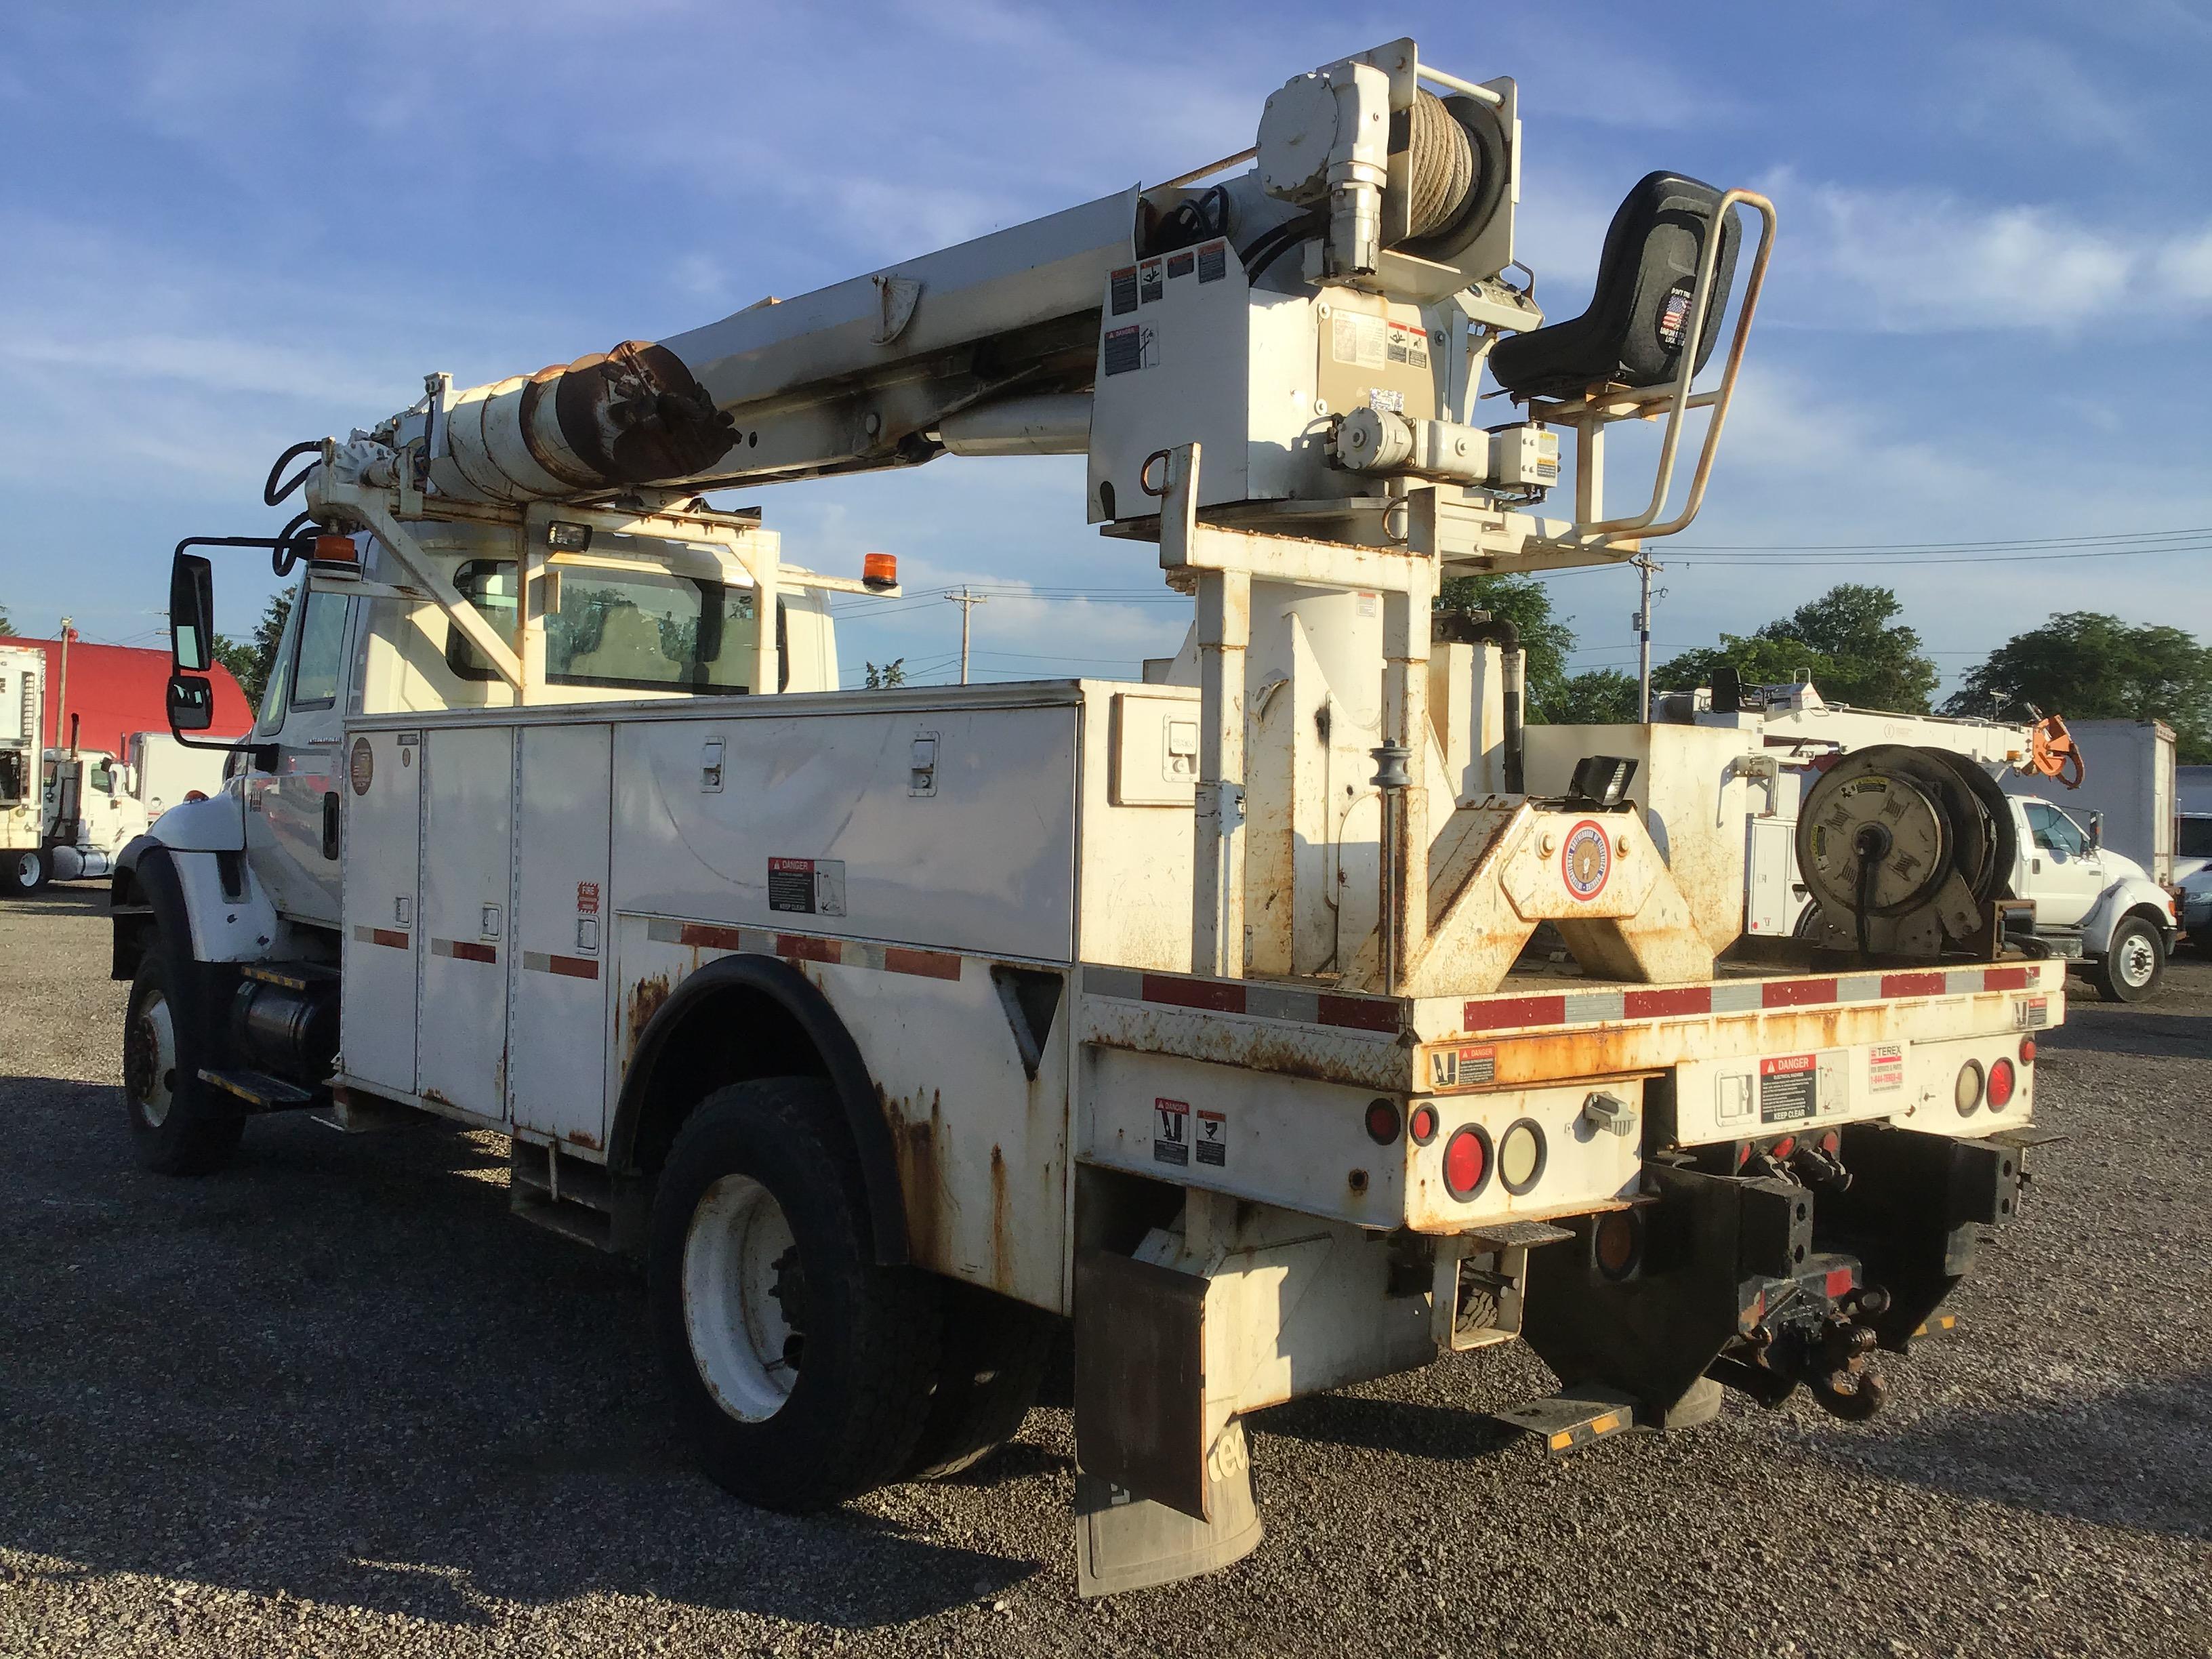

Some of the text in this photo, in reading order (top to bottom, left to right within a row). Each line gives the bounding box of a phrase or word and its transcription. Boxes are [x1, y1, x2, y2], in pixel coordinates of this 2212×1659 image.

[781, 860, 808, 870] DANGER
[1471, 1048, 1493, 1057] DANGER
[1877, 1045, 1902, 1057] TEREX
[1778, 1057, 1809, 1071] DANGER
[1774, 1109, 1805, 1120] KEEP CLEAR
